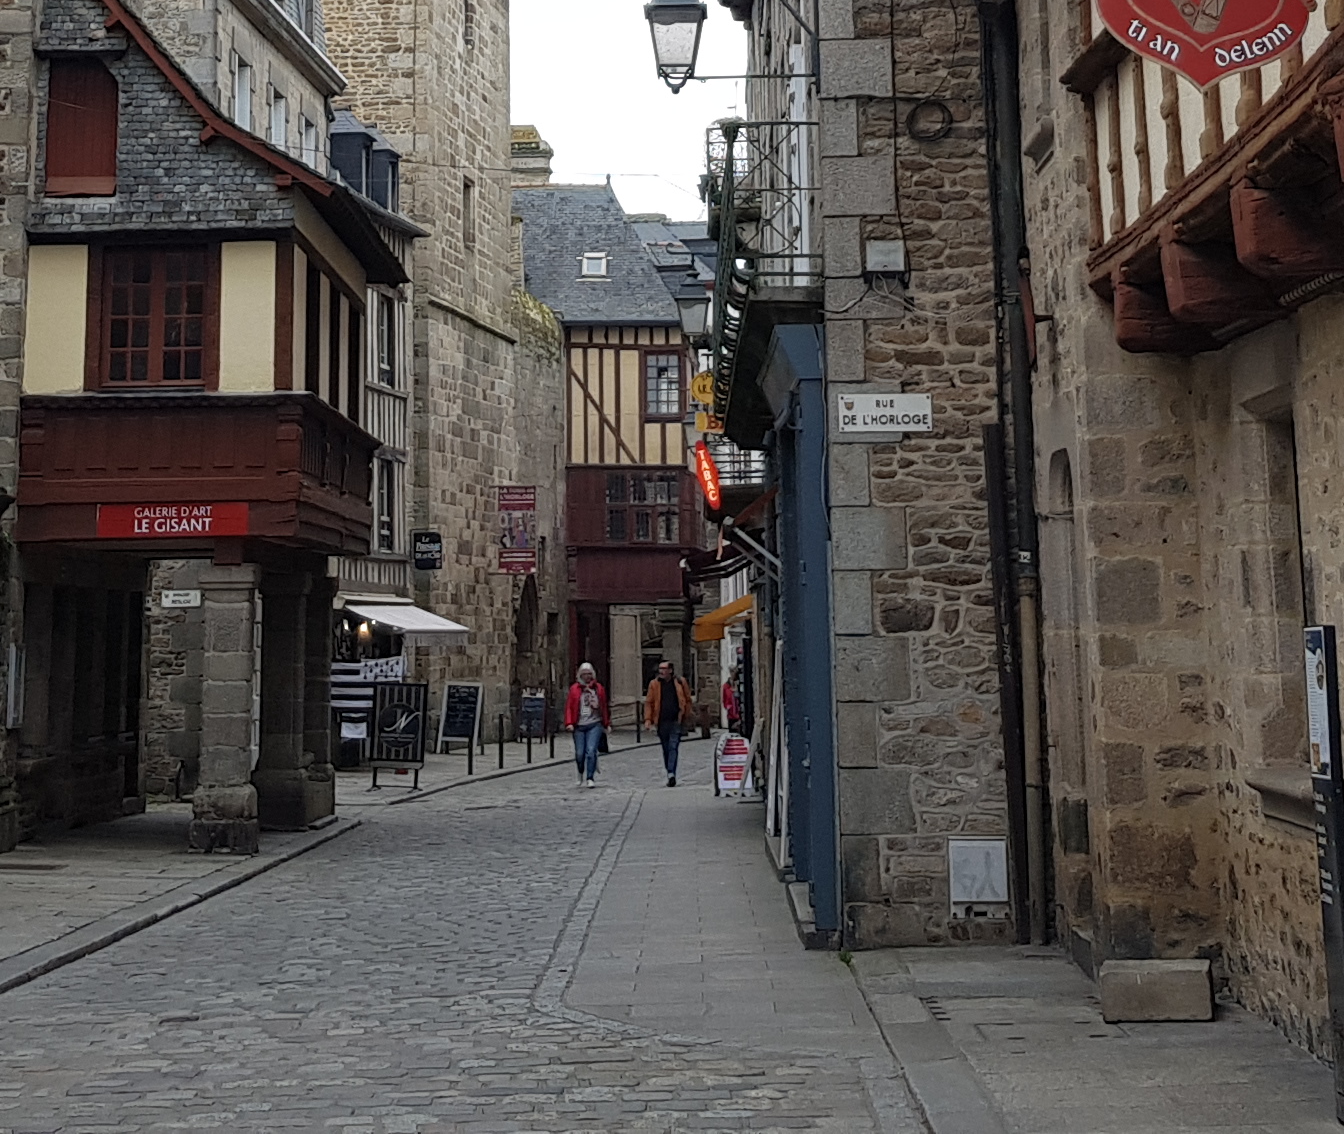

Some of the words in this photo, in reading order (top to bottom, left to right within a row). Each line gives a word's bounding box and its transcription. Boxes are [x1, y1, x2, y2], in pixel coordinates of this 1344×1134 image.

[875, 399, 894, 408] RUE
[843, 414, 857, 426] DE
[862, 413, 929, 426] L'HORLOGE
[697, 449, 718, 501] TABAC
[134, 507, 178, 518] GALERIE
[180, 505, 213, 517] D'ART
[134, 518, 150, 533] LE
[154, 517, 213, 533] GISANT
